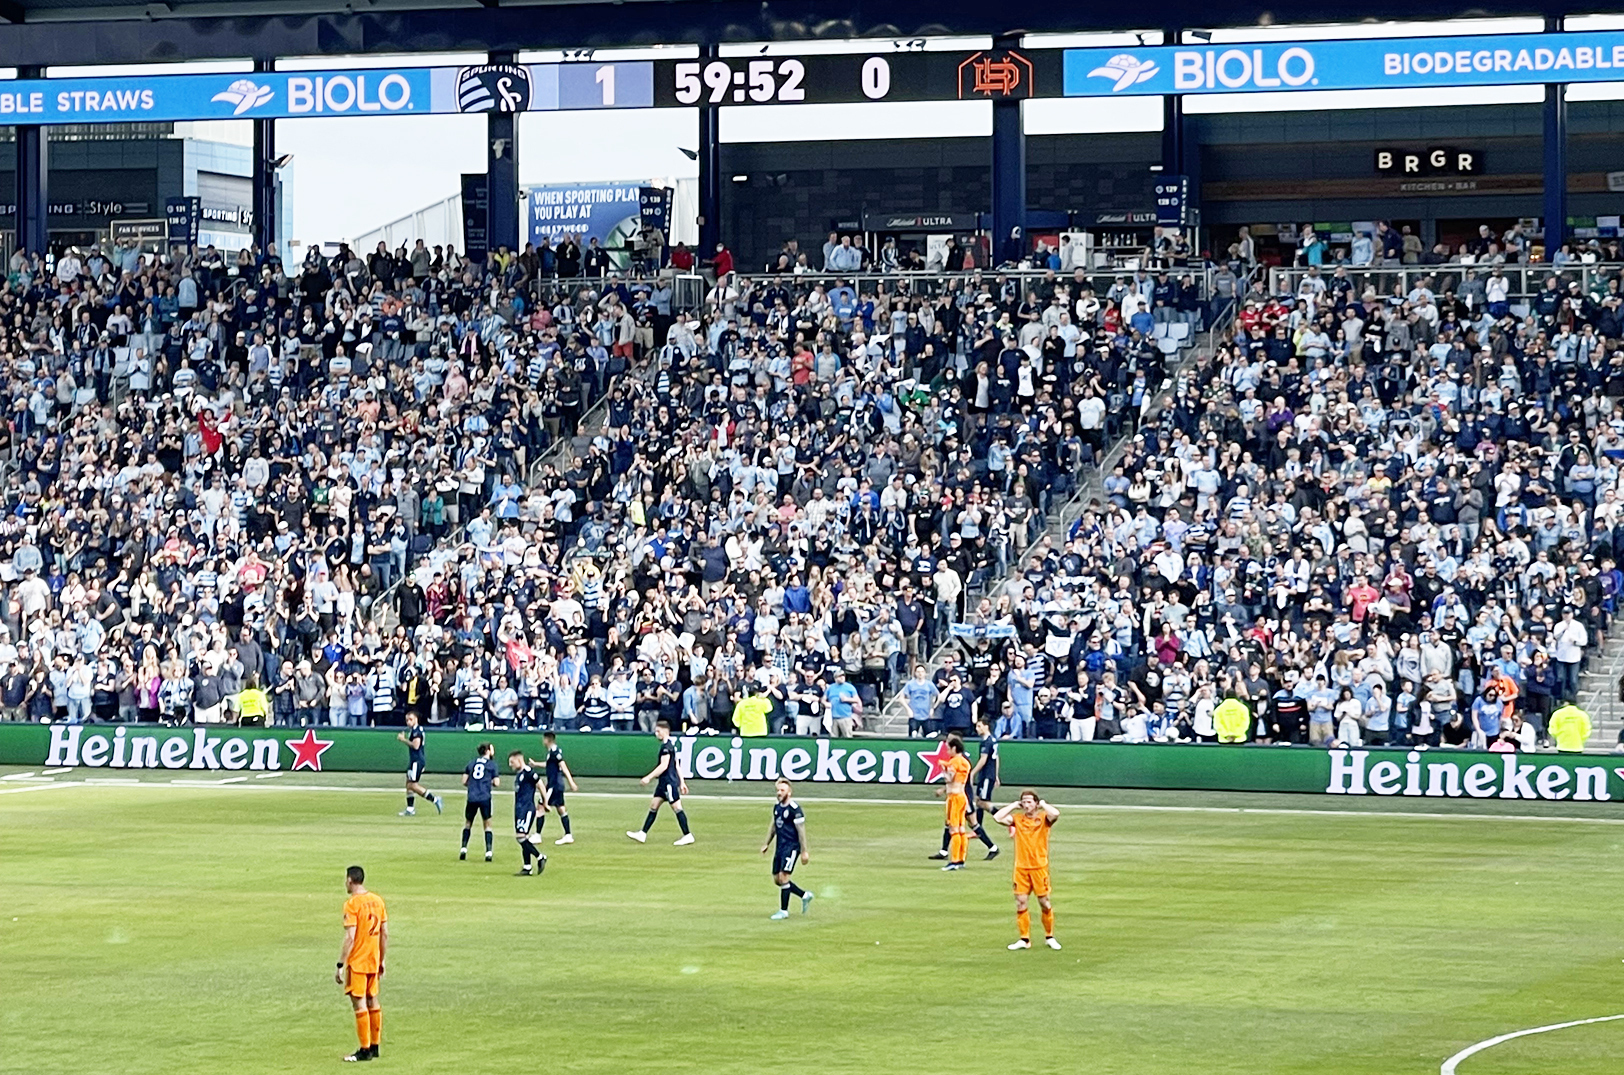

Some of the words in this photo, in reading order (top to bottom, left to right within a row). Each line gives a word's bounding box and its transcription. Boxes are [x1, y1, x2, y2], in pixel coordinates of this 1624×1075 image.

[1384, 46, 1624, 75] BIODEGRADABLE
[595, 65, 615, 105] 1
[675, 60, 805, 104] 59:52
[861, 57, 890, 99] 0
[0, 93, 43, 113] BLE
[57, 90, 154, 111] STRAWS
[1378, 150, 1473, 173] BRGR
[534, 191, 563, 205] WHEN
[565, 188, 613, 204] SPORTING
[90, 201, 122, 216] Style
[203, 208, 237, 222] SPORTING
[534, 206, 552, 220] YOU
[554, 205, 578, 219] PLAY
[579, 204, 592, 218] AT
[1132, 213, 1157, 222] ULTR
[922, 217, 953, 226] ULTRA
[44, 724, 282, 770] Heineken
[672, 736, 914, 783] Heineken
[472, 763, 485, 780] 8
[1325, 749, 1611, 801] Heineken
[369, 913, 379, 936] 2
